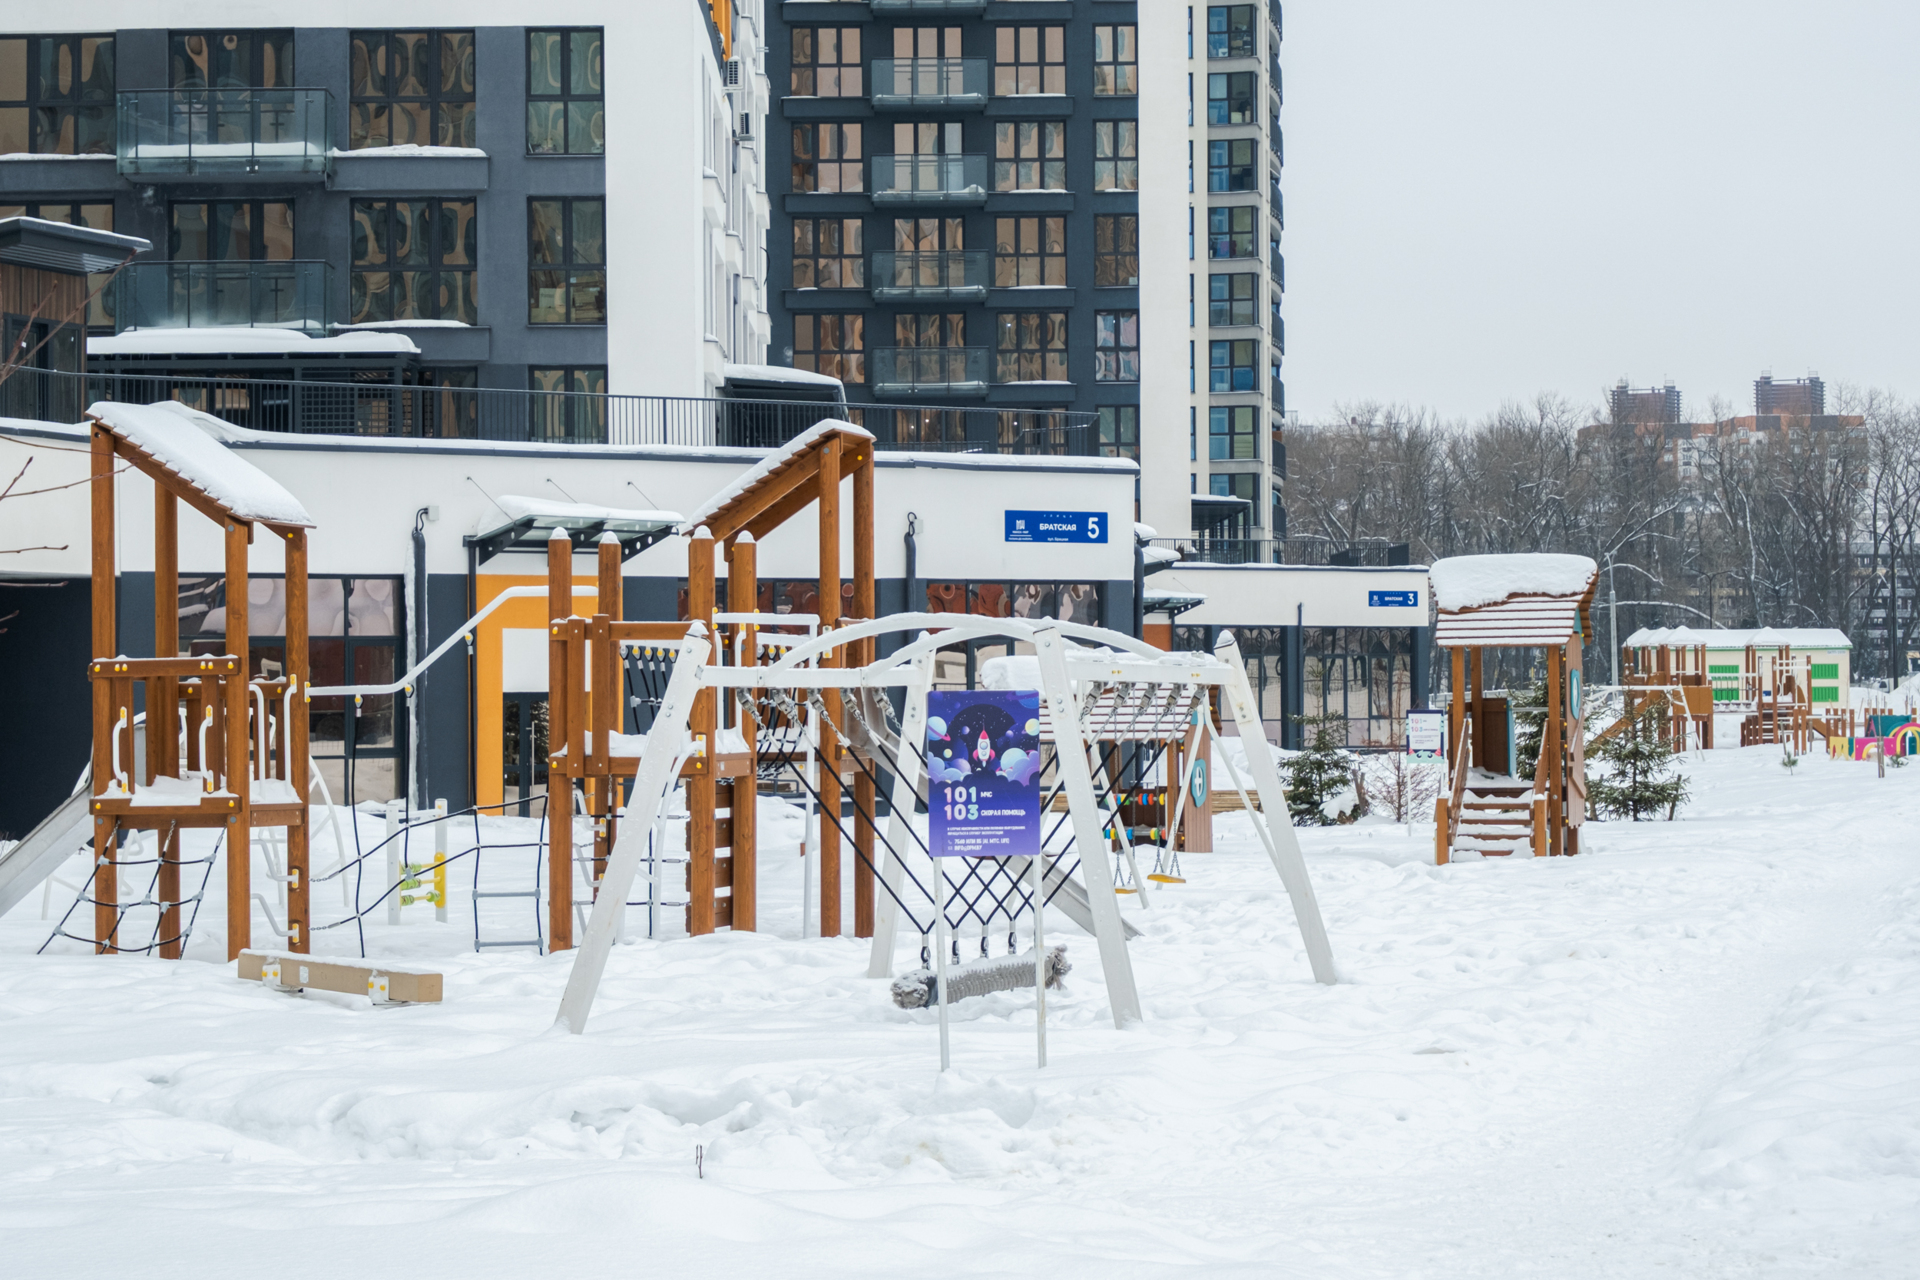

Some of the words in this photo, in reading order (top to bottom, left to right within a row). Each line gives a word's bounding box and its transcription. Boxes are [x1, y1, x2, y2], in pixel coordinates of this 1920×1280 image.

[1039, 522, 1076, 531] БРАТСКАЯ
[1087, 517, 1100, 539] 5
[1407, 593, 1414, 605] 3
[944, 786, 976, 803] 101
[944, 804, 979, 820] 103
